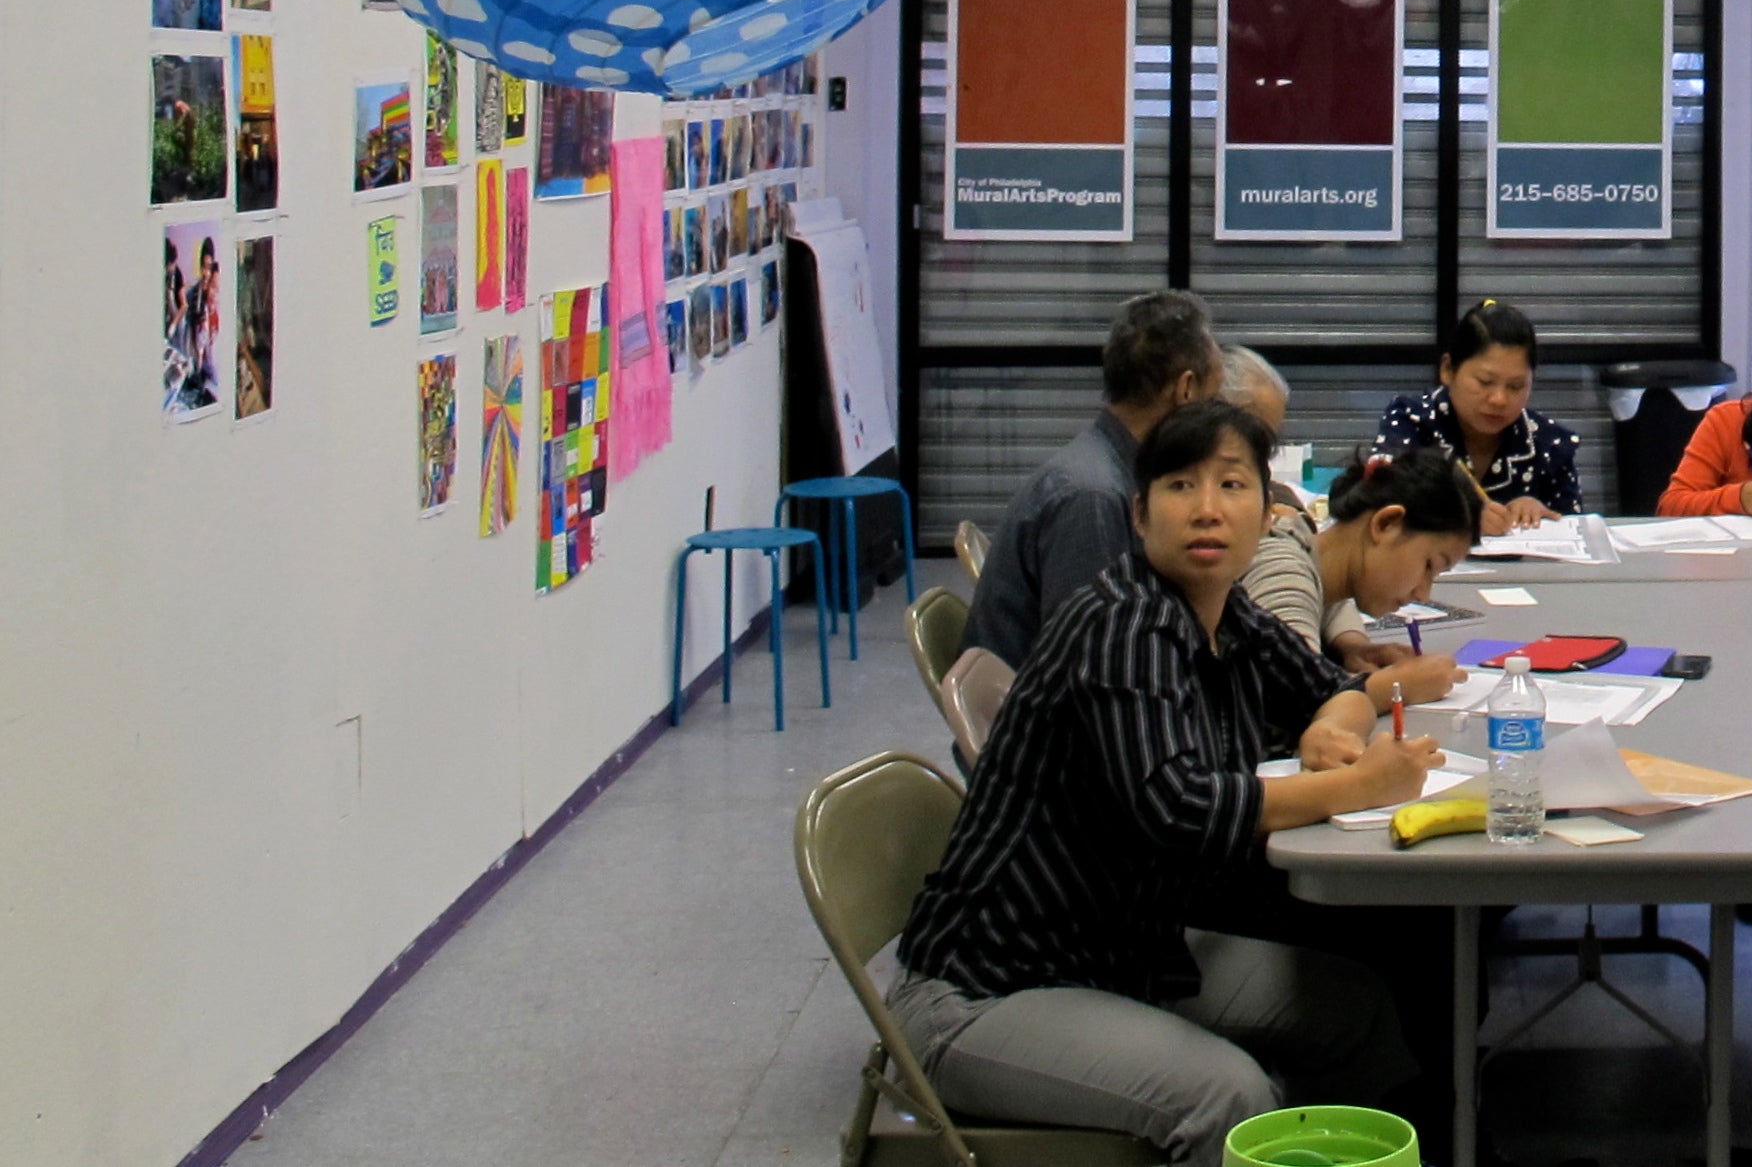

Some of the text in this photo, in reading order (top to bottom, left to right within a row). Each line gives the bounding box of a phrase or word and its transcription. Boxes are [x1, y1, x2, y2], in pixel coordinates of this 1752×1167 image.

[958, 188, 1122, 206] MuralArtsProgram
[1240, 185, 1378, 208] muralarts.org
[1500, 184, 1659, 203] 215-685-0750
